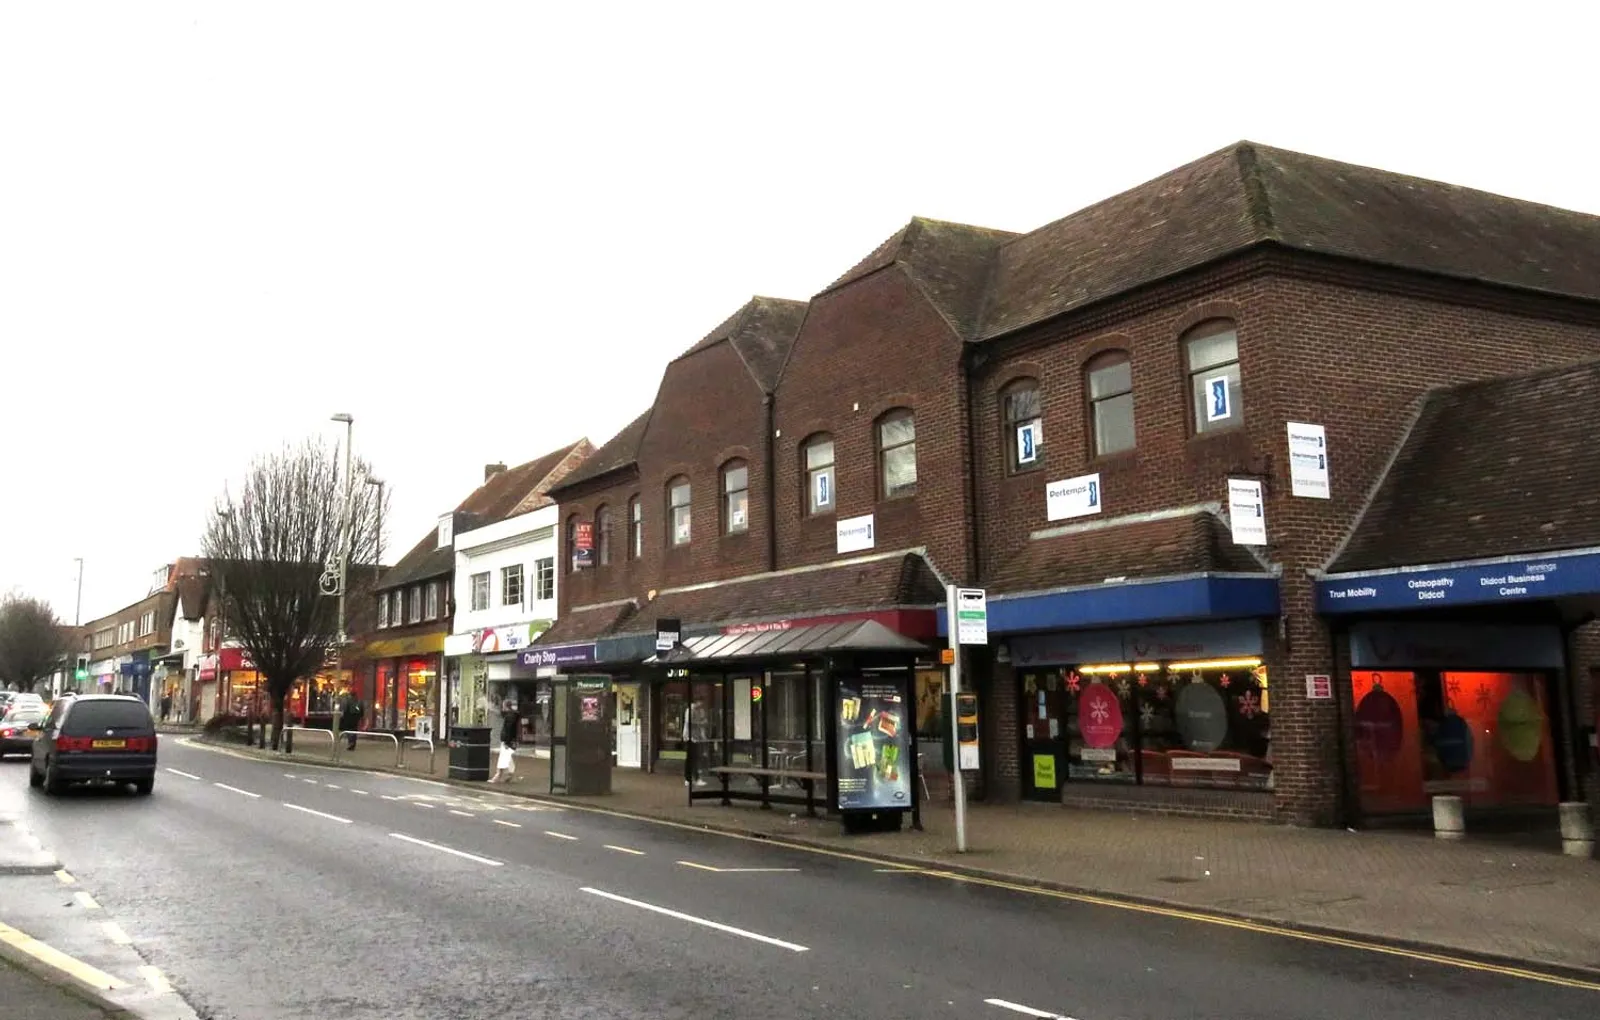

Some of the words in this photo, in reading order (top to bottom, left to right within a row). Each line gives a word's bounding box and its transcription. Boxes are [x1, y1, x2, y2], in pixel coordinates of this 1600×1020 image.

[1050, 486, 1087, 498] Pertemps
[838, 527, 867, 537] Pertemps
[1526, 563, 1557, 574] Jennings
[1408, 577, 1455, 589] Osteopathy
[1480, 576, 1507, 586] Didcot
[1508, 574, 1545, 583] Business
[1329, 589, 1346, 599] True
[1347, 587, 1377, 598] Mobility
[1418, 590, 1445, 600] Didcot
[1499, 587, 1527, 596] Centre
[524, 652, 542, 666] Charity
[543, 650, 556, 665] Shop
